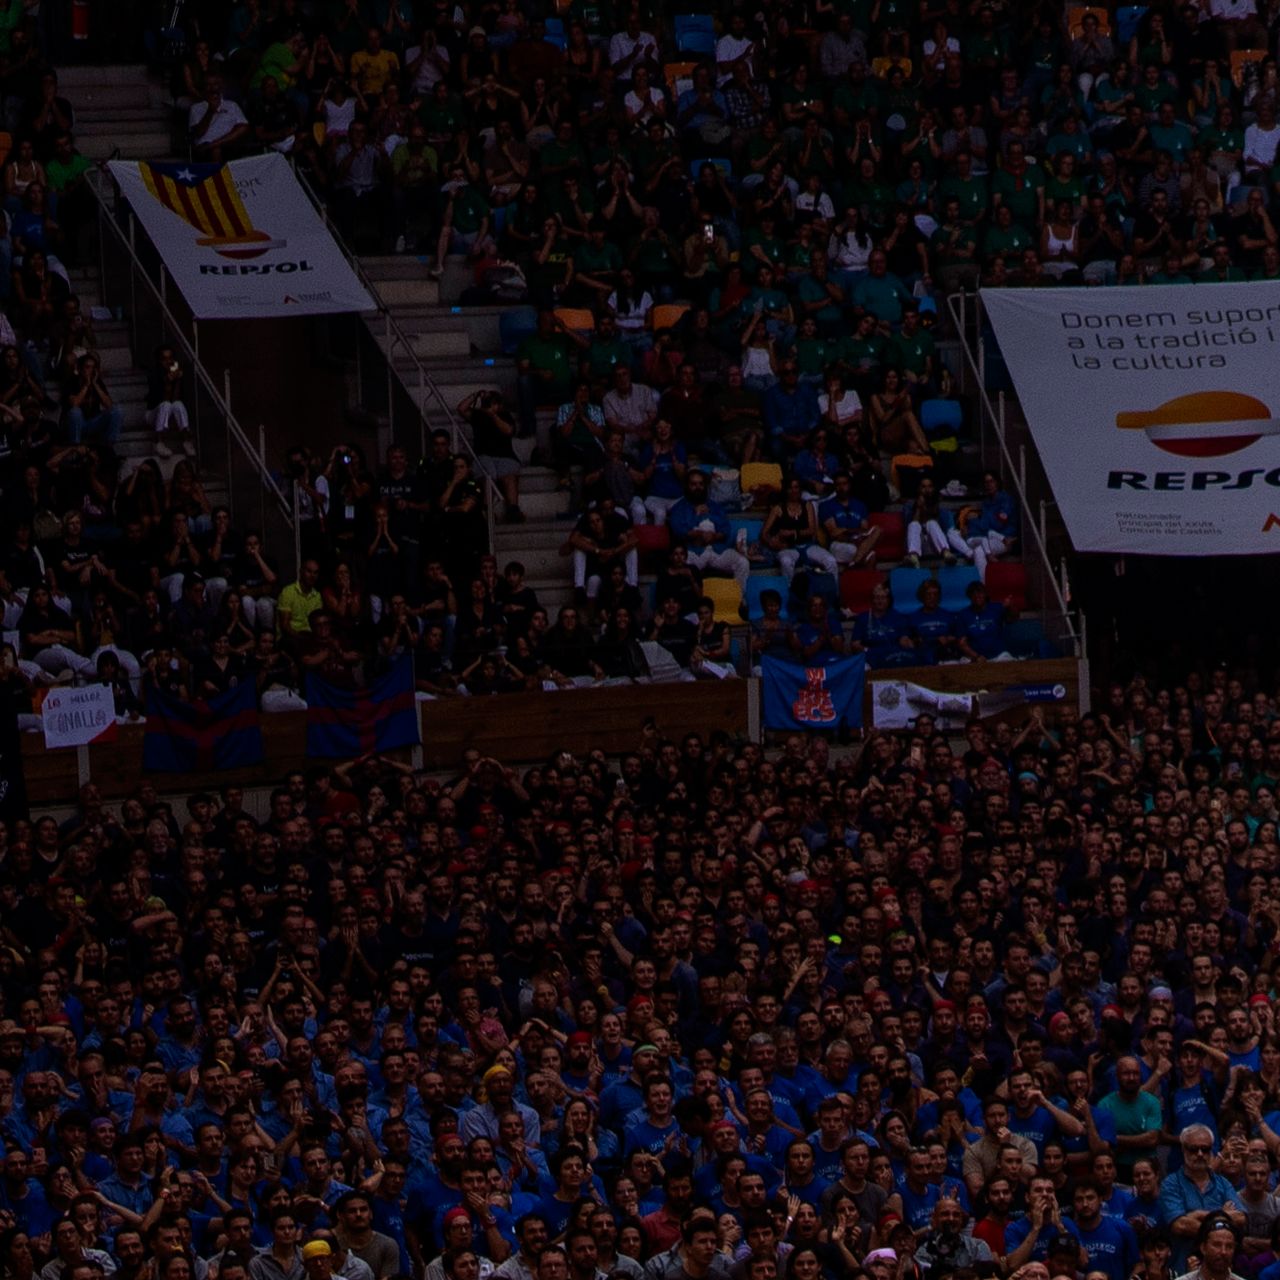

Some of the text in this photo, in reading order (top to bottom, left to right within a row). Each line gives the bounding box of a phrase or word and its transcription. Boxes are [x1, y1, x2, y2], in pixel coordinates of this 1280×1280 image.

[199, 260, 315, 276] REPSOL
[1061, 312, 1176, 329] Donem
[1068, 326, 1275, 350] a la tradició i
[1071, 353, 1227, 370] la cultura
